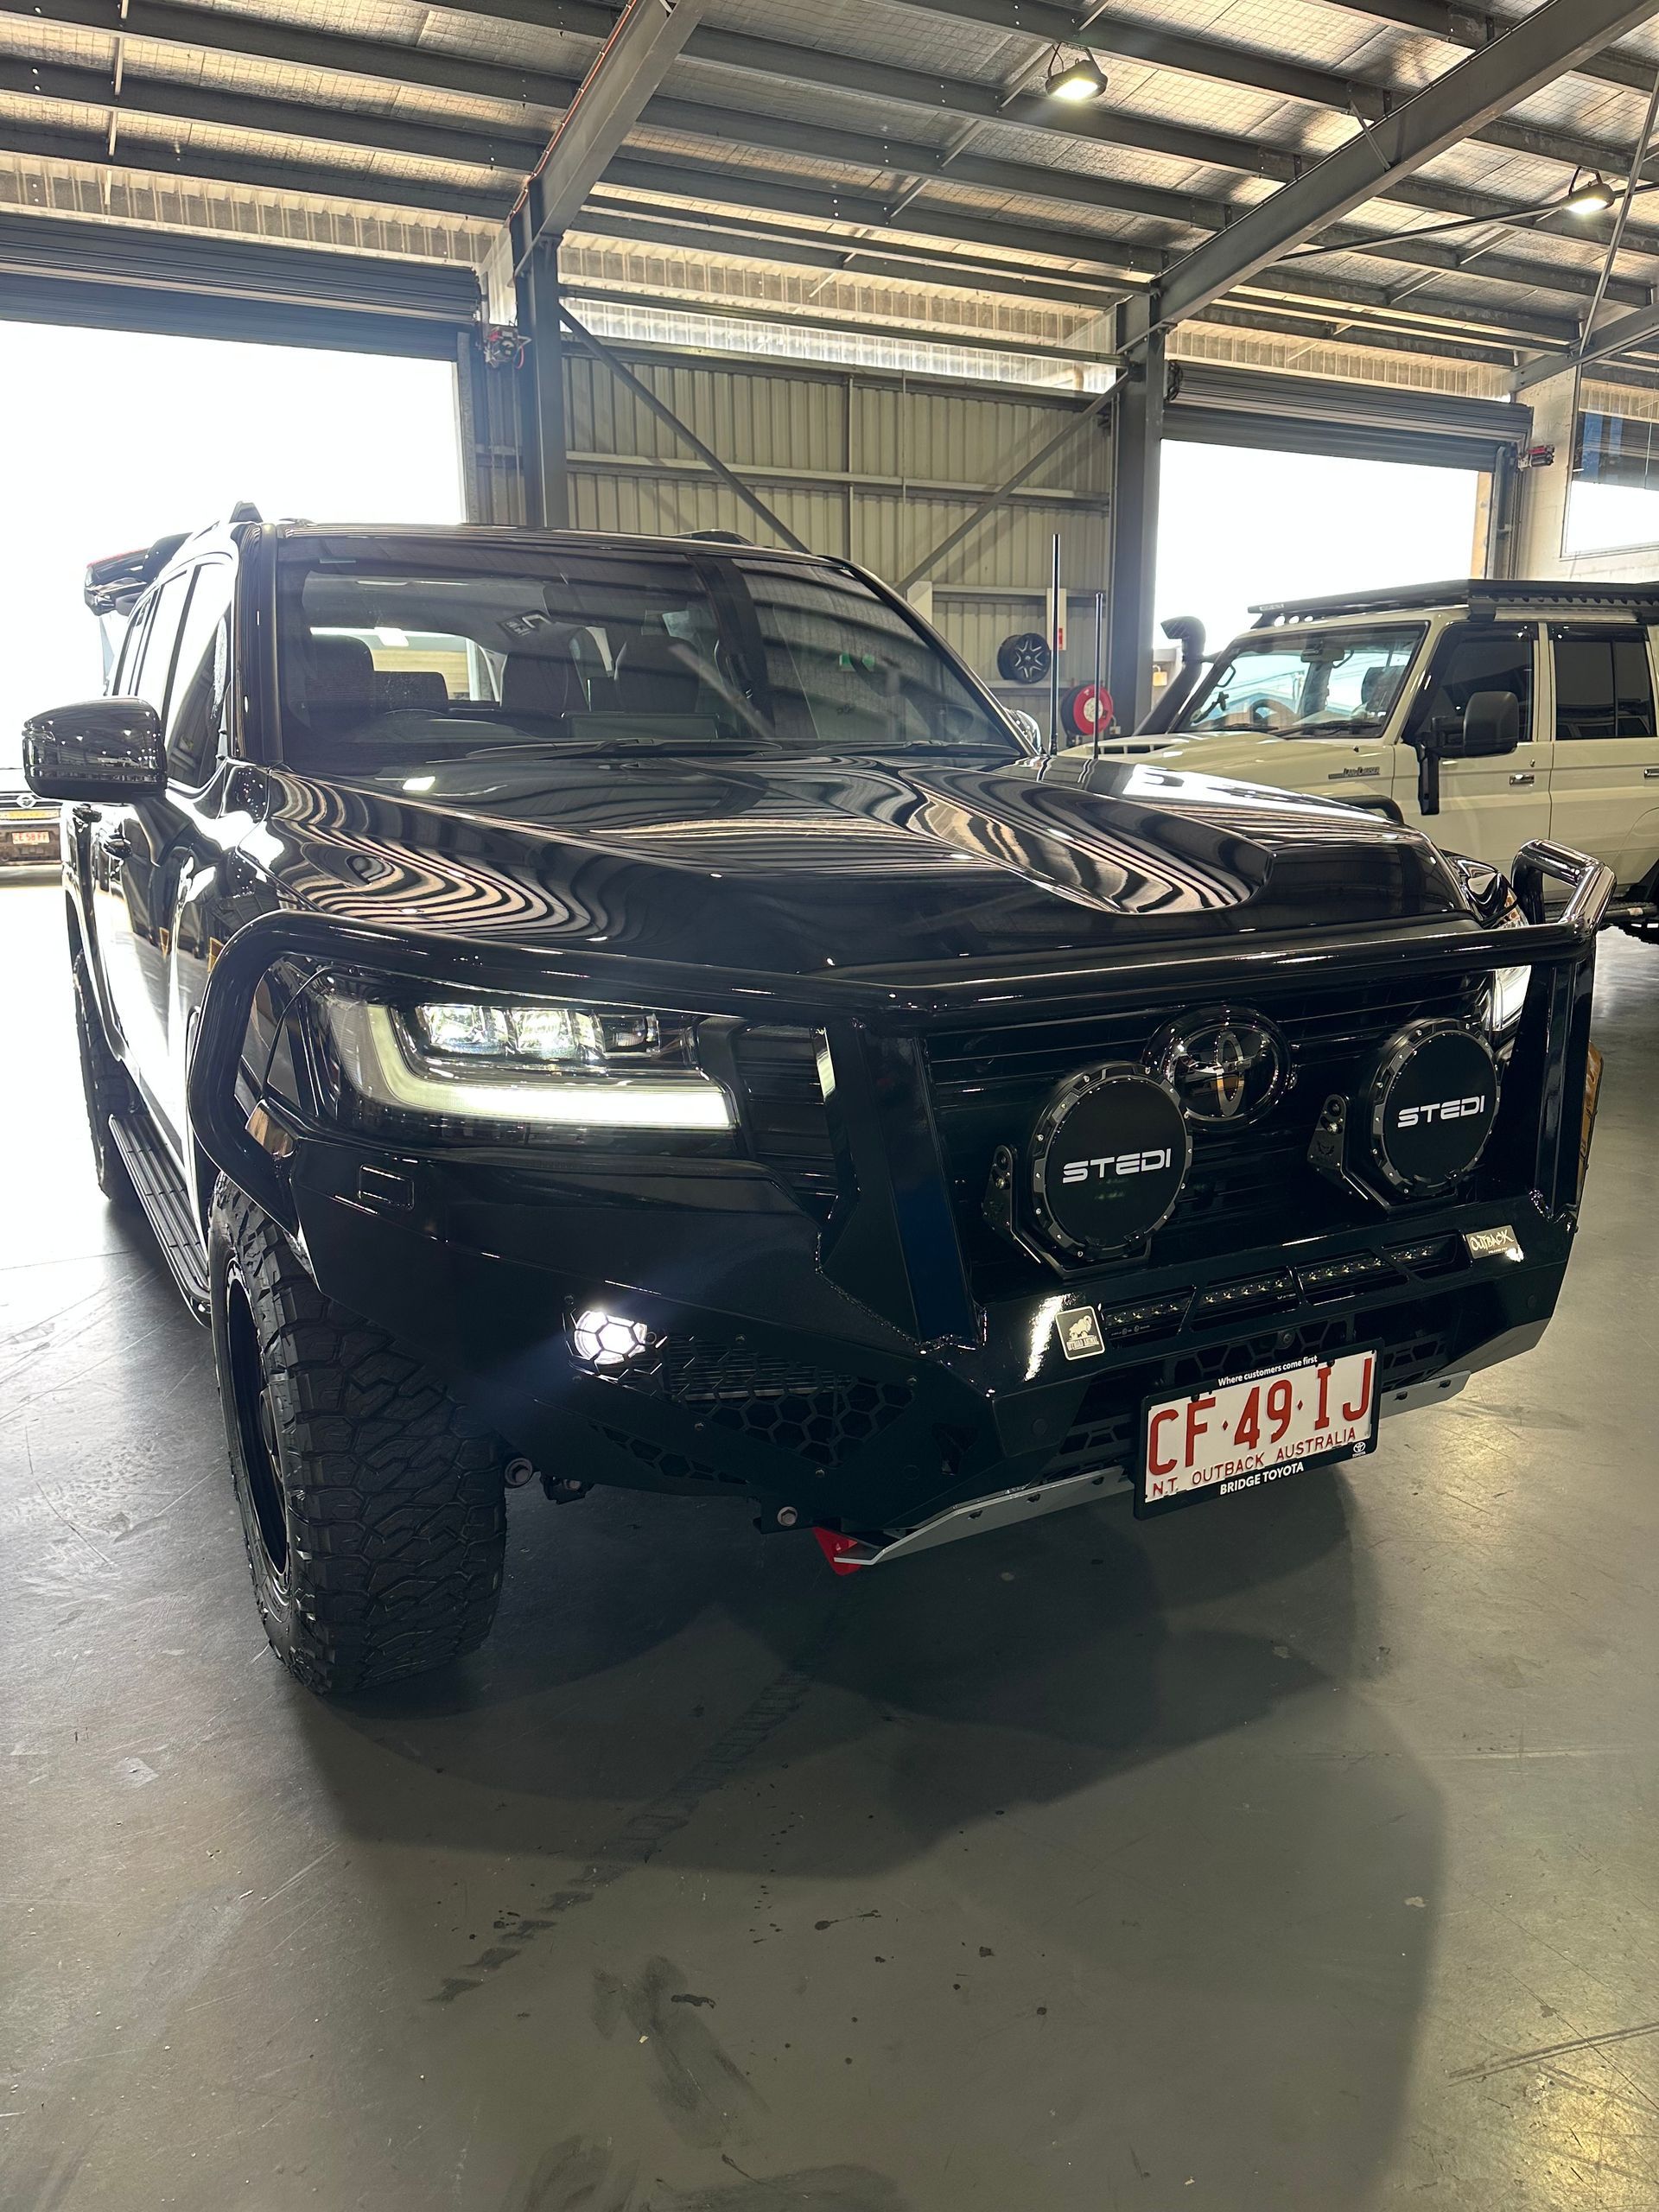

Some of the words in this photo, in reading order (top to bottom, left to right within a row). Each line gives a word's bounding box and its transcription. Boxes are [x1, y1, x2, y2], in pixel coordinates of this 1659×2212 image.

[1397, 1095, 1485, 1128] STEDI
[1062, 1148, 1172, 1184] STEDI
[1218, 1375, 1243, 1387] Where
[1243, 1365, 1281, 1381] customers
[1282, 1361, 1302, 1370] come
[1302, 1355, 1318, 1365] first
[1192, 1452, 1265, 1485] OUTBACK
[1276, 1427, 1356, 1462] AUSTRALIA
[1219, 1472, 1261, 1496] BRIDGE
[1262, 1461, 1305, 1483] TOYOTA
